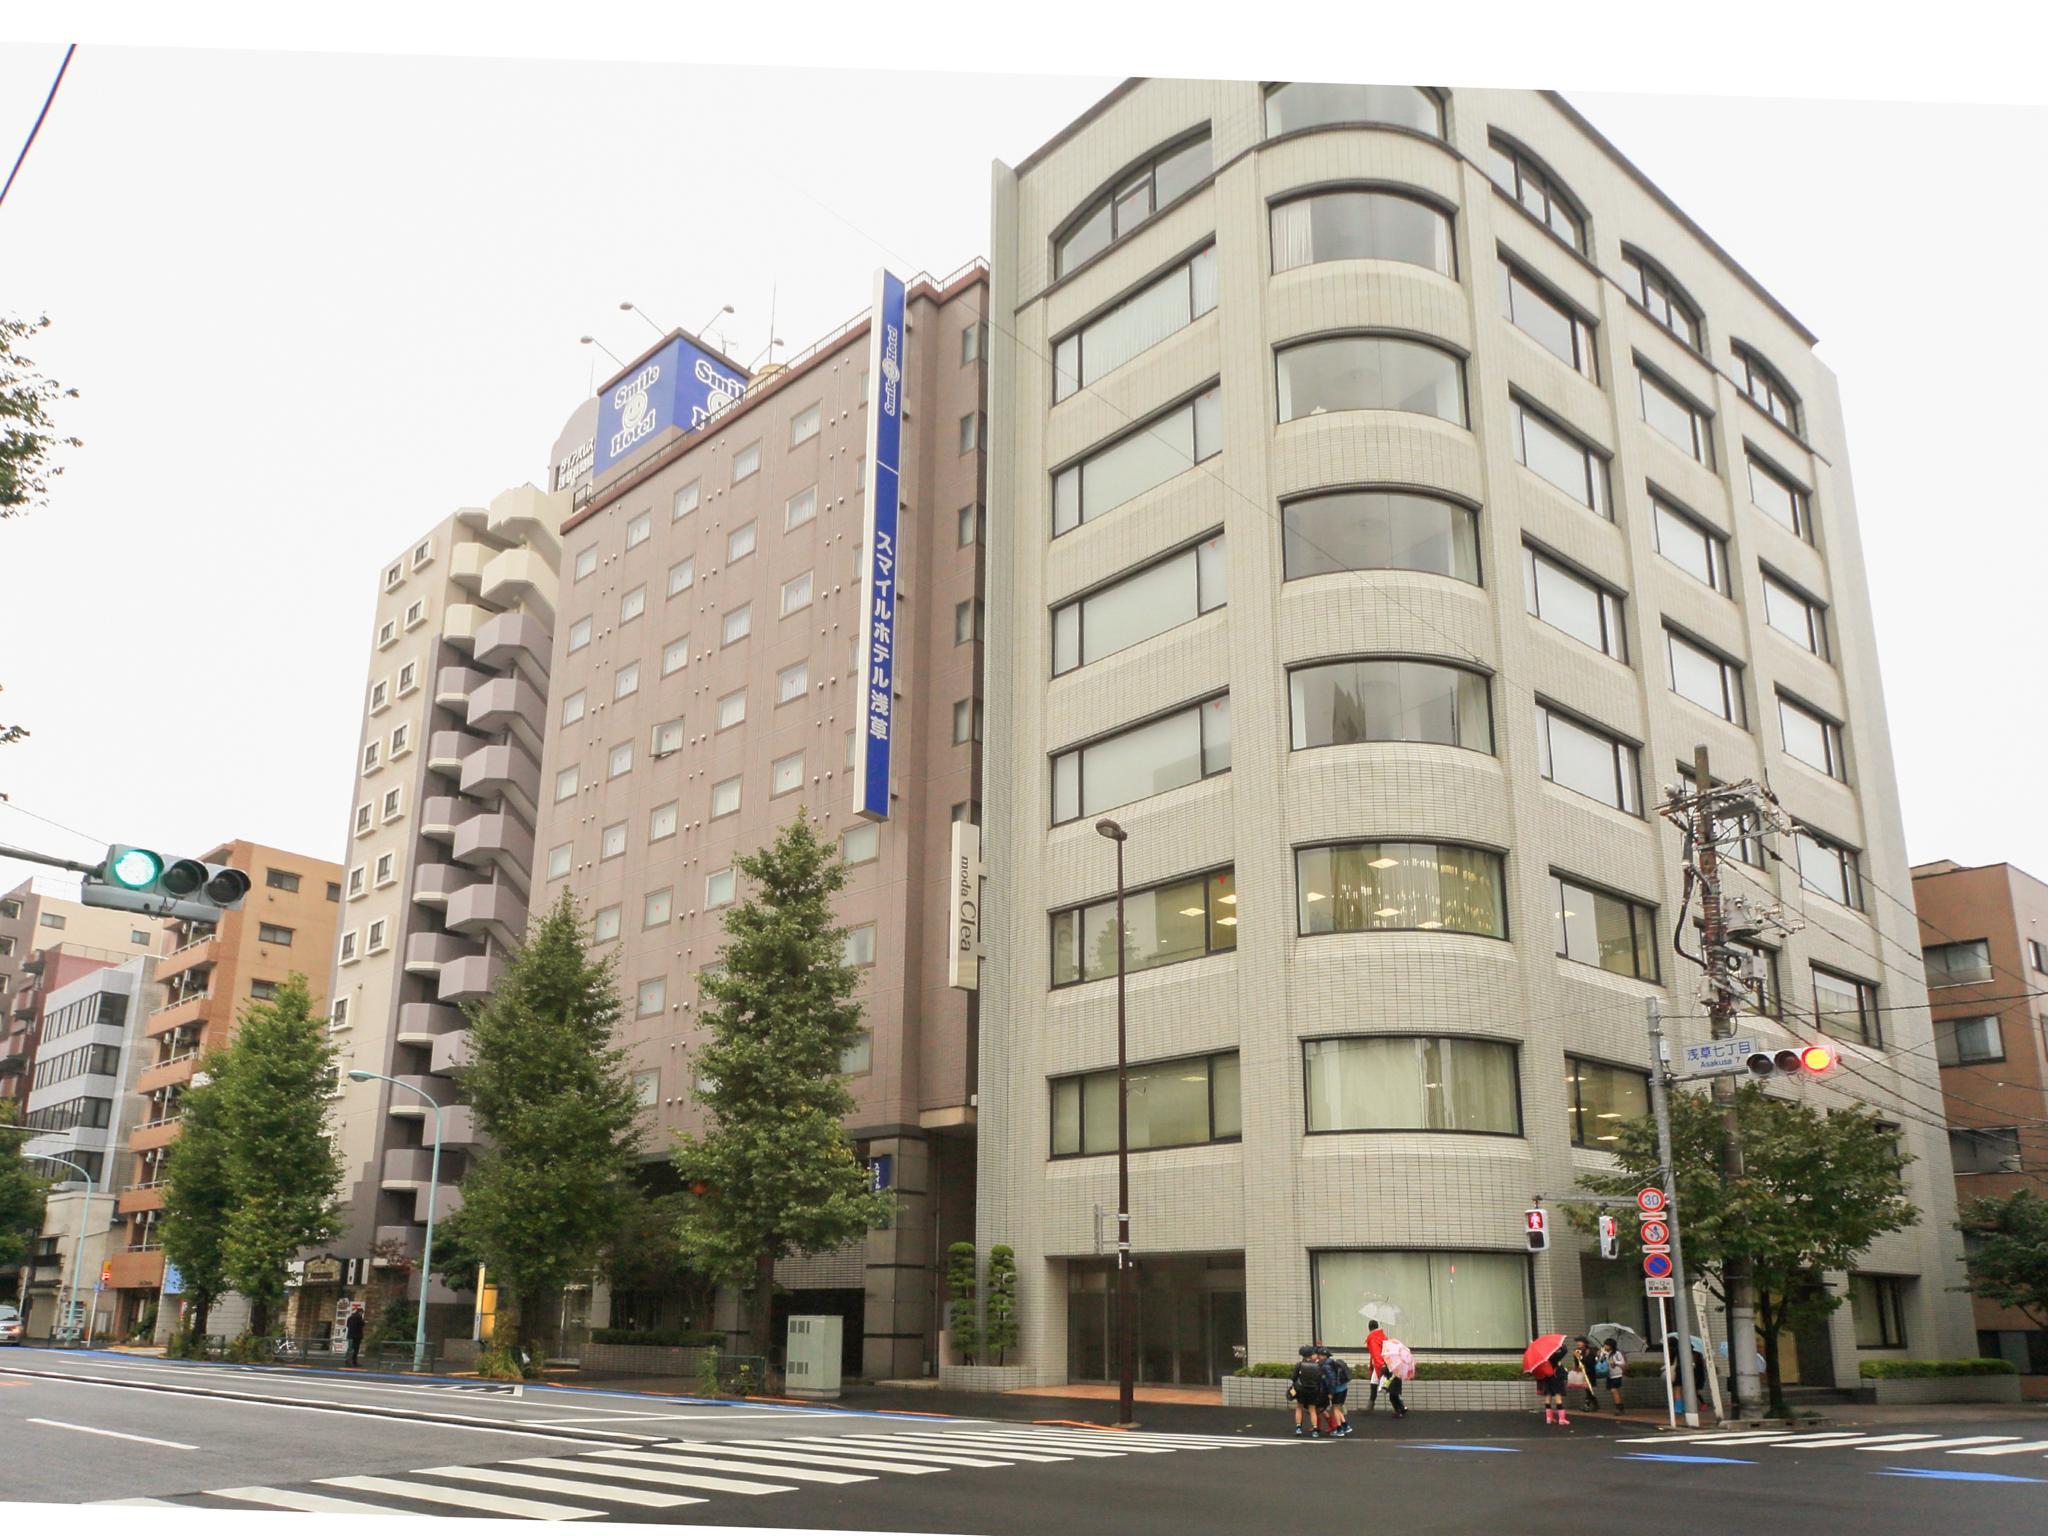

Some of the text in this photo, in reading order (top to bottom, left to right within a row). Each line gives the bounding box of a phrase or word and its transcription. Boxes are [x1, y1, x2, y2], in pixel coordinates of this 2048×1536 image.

[886, 324, 898, 362] Hotel
[615, 365, 660, 410] Smile
[695, 359, 746, 402] Smil
[610, 407, 656, 457] Hotel
[870, 530, 893, 741] スマイルホテル浅草
[960, 856, 977, 952] moda Clea
[1687, 1041, 1751, 1061] 浅草七丁目
[1700, 1056, 1741, 1068] Asakusa 7
[1644, 1194, 1660, 1206] 30
